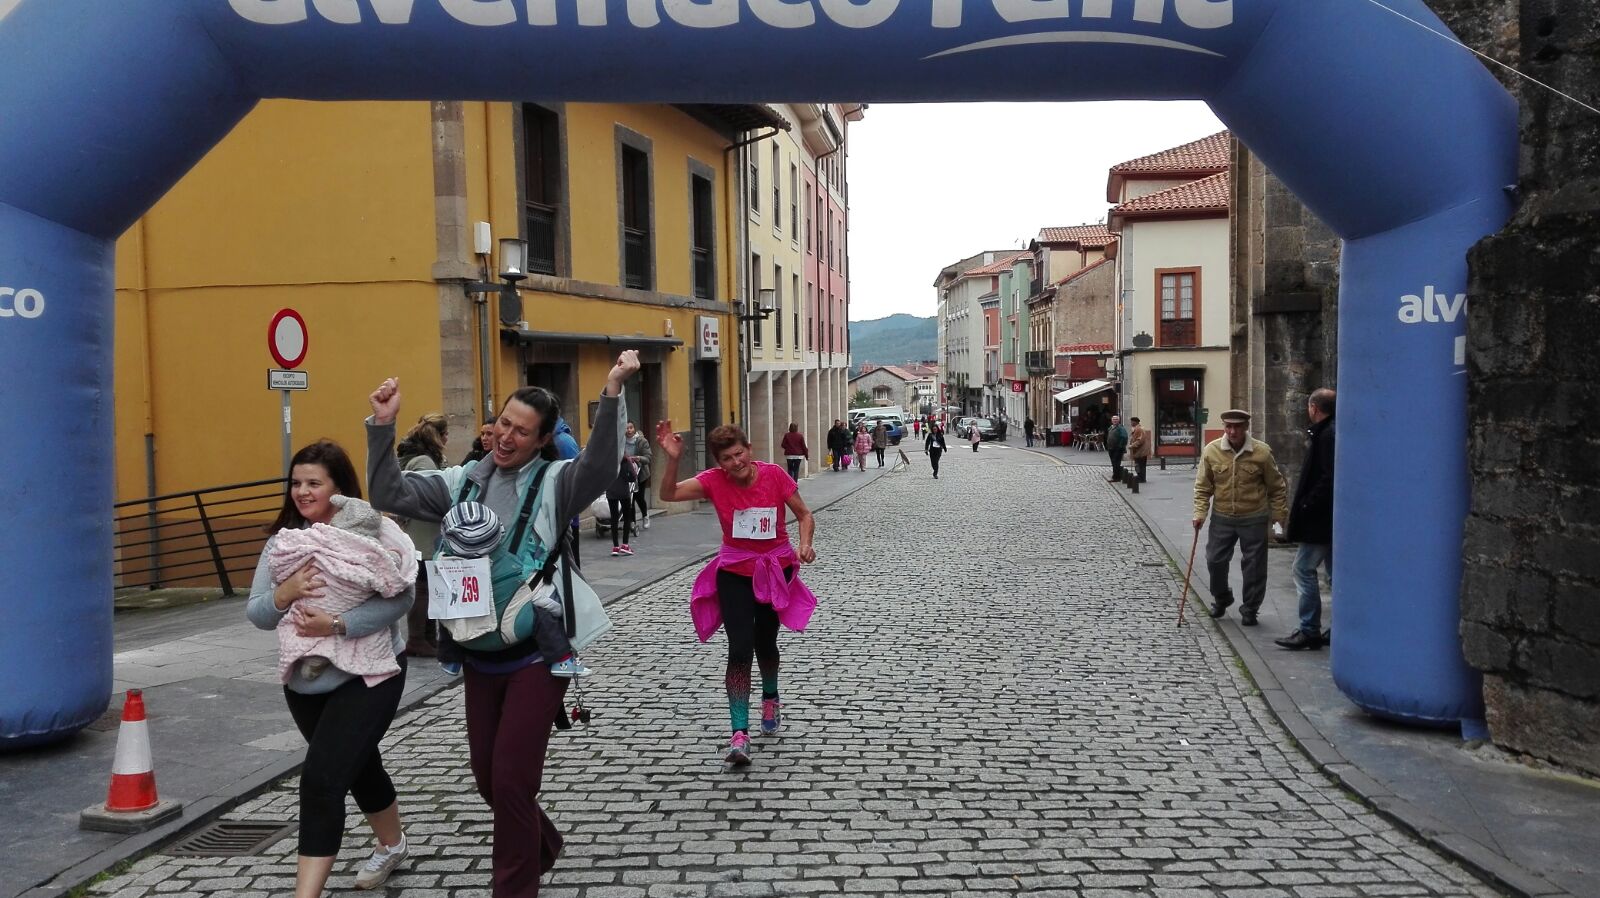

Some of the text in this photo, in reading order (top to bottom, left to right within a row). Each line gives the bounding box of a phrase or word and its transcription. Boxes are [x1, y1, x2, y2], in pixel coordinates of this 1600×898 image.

[1398, 285, 1468, 324] alv
[759, 516, 771, 533] 191
[461, 576, 480, 603] 259
